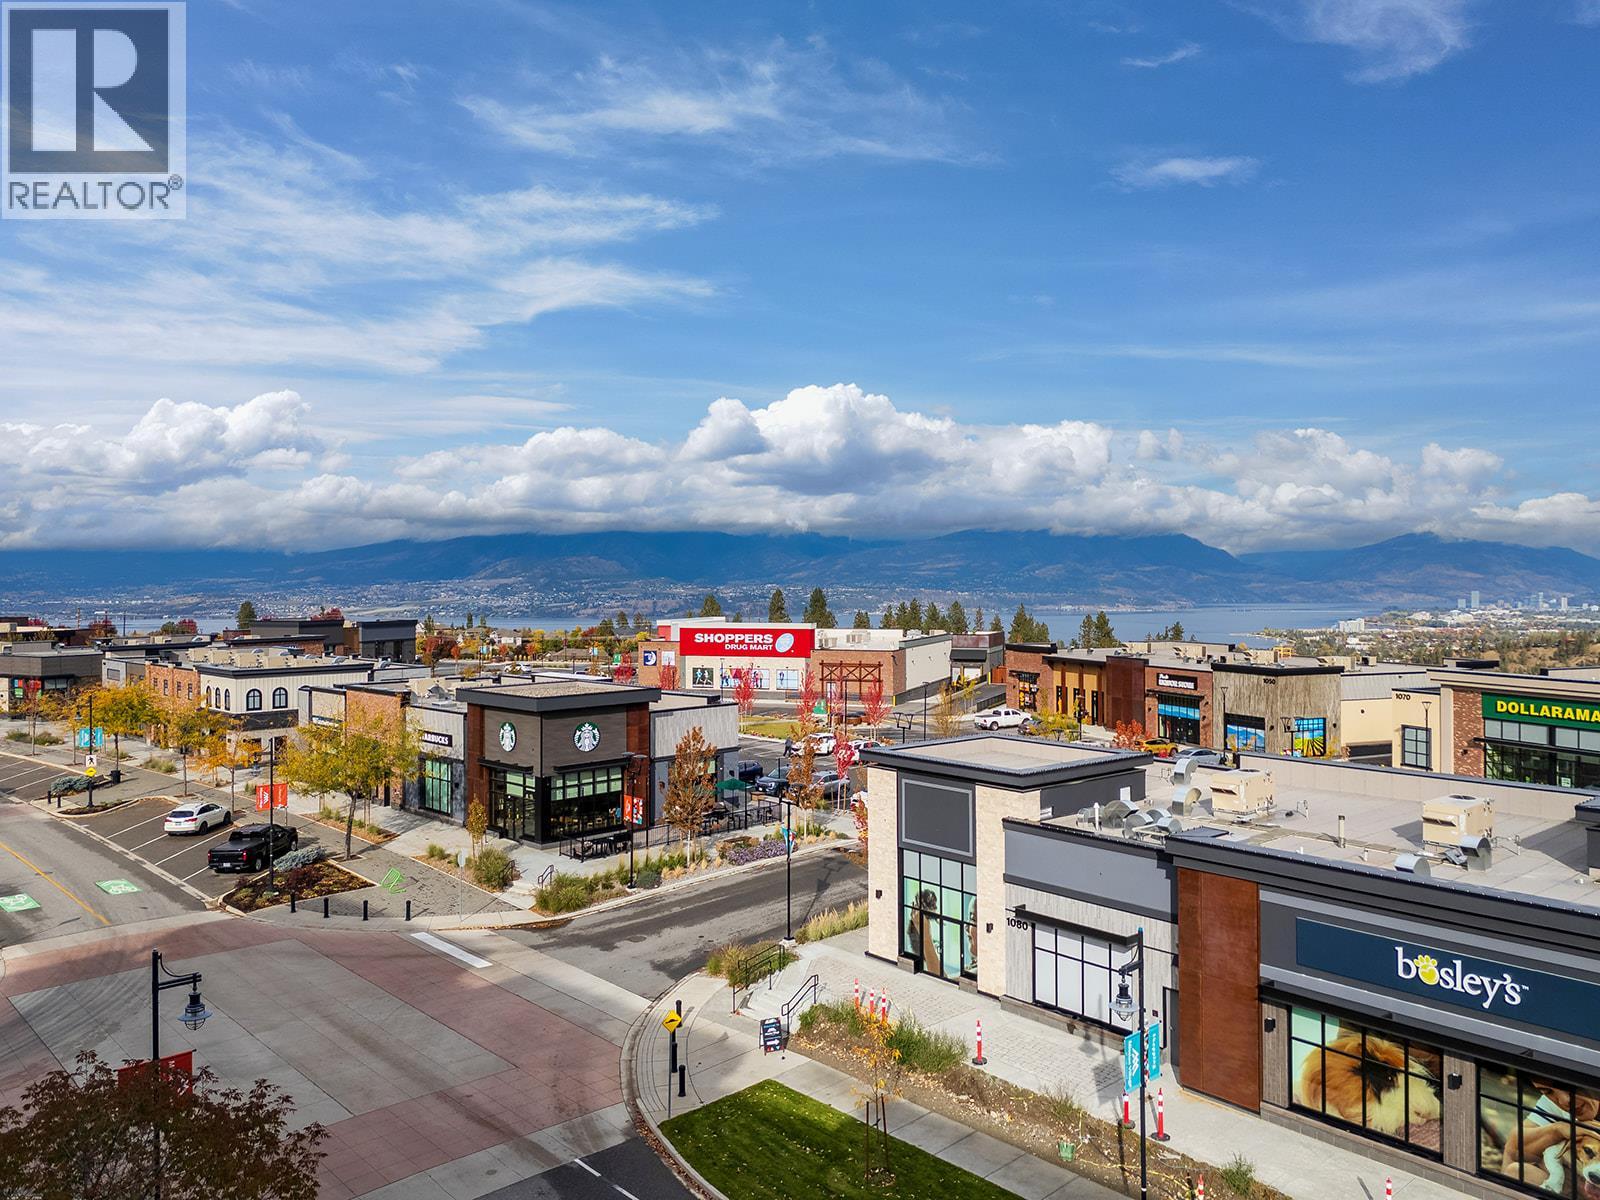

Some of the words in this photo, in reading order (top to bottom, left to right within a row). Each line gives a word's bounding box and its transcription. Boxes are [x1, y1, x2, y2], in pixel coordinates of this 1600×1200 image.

[694, 633, 774, 644] SHOPPERS
[1395, 693, 1411, 701] 1070
[1496, 700, 1600, 723] DOLLARAMA
[1006, 917, 1029, 931] 1080
